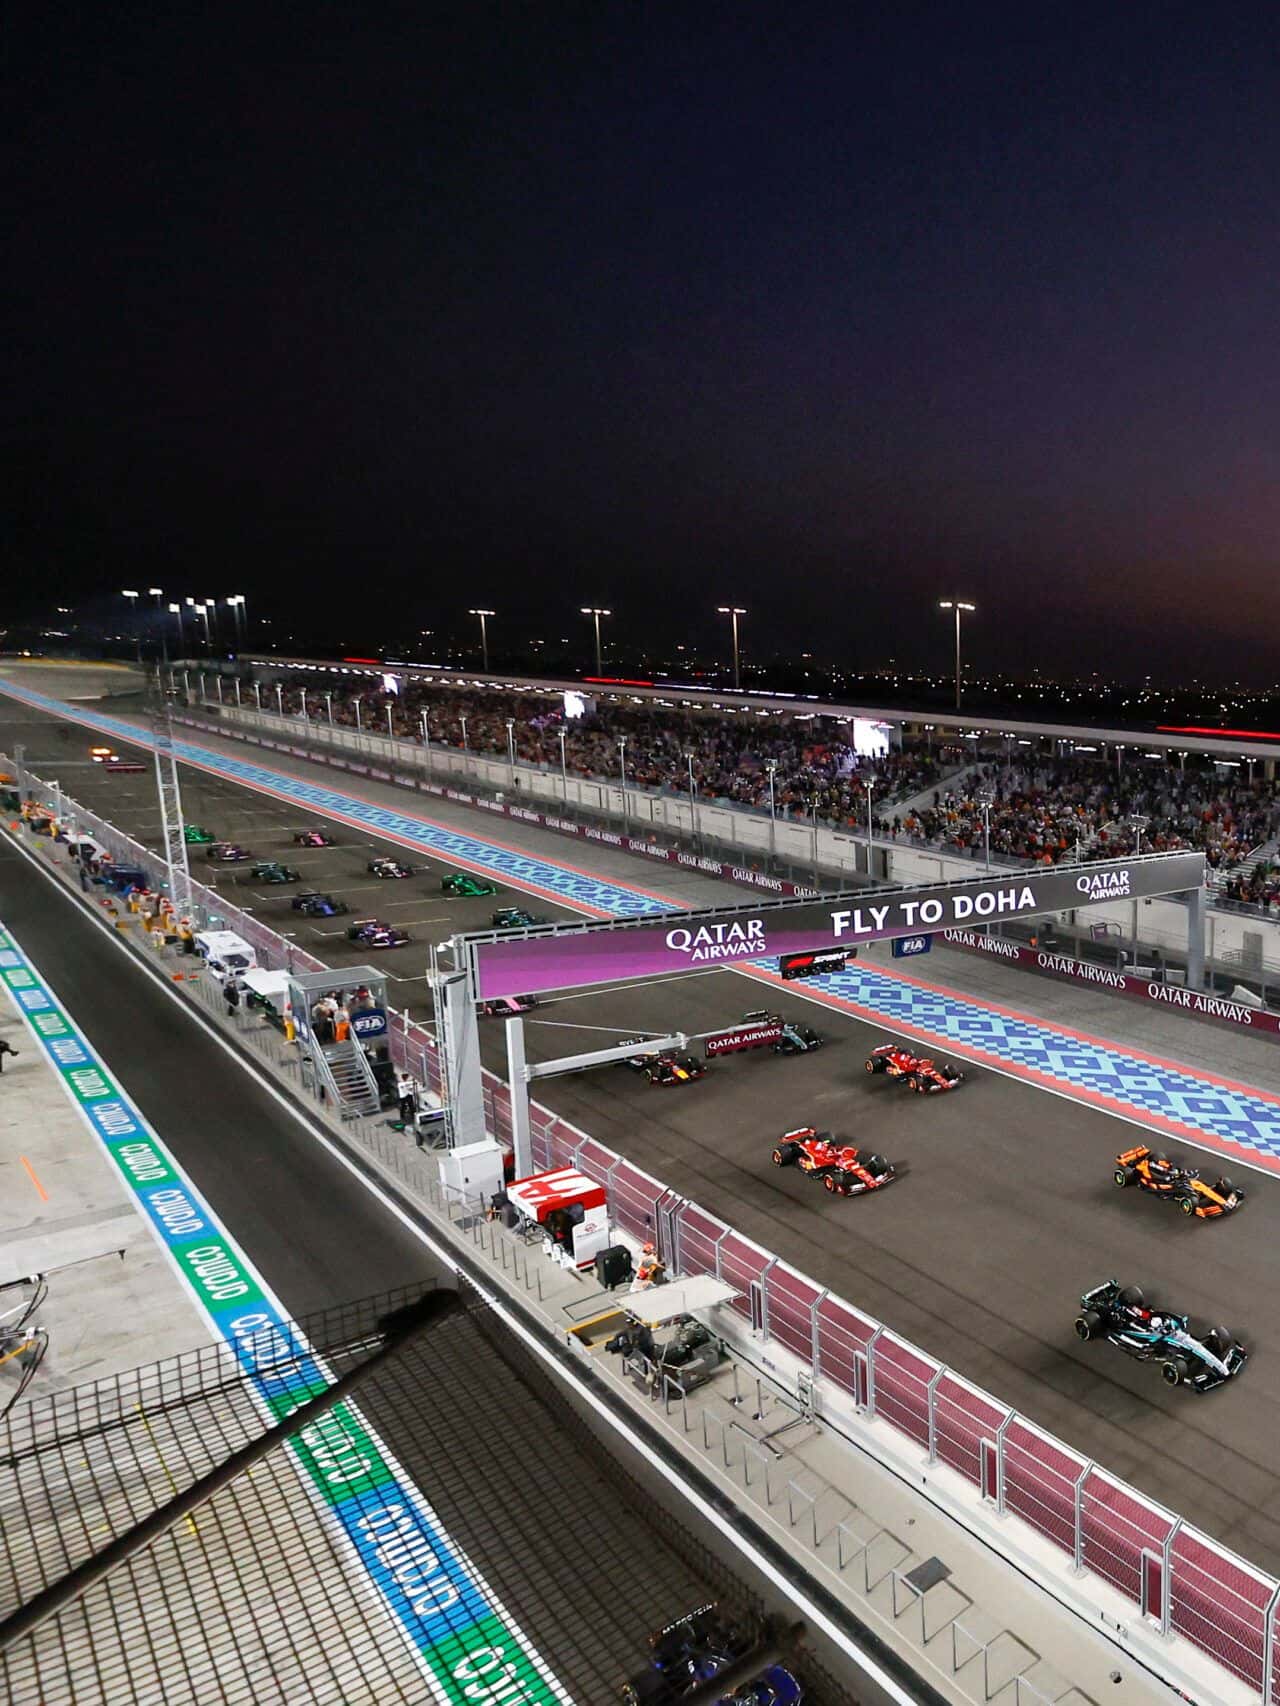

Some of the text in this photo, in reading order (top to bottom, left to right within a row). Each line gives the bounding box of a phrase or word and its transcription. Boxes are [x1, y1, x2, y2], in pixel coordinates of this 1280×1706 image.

[677, 852, 697, 868] QATAR
[732, 868, 783, 892] QATAR AIRWAYS
[1076, 870, 1130, 895] QATAR
[1088, 884, 1130, 901] AIRWAYS
[831, 886, 1036, 937] FLY TO DOHA
[665, 919, 764, 952] QATAR
[691, 938, 767, 961] AIRWAYS
[903, 938, 925, 953] FIA
[944, 928, 1019, 960] QATAR AIRWAYS
[1037, 952, 1126, 990] QATAR AIRWAYS
[1148, 983, 1252, 1025] QATAR AIRWAYS
[355, 1018, 382, 1031] FIA
[708, 1028, 782, 1050] QATAR AIRWAYS
[149, 1189, 204, 1235] aramco
[186, 1245, 249, 1301] aramco
[357, 1504, 460, 1617] aramco
